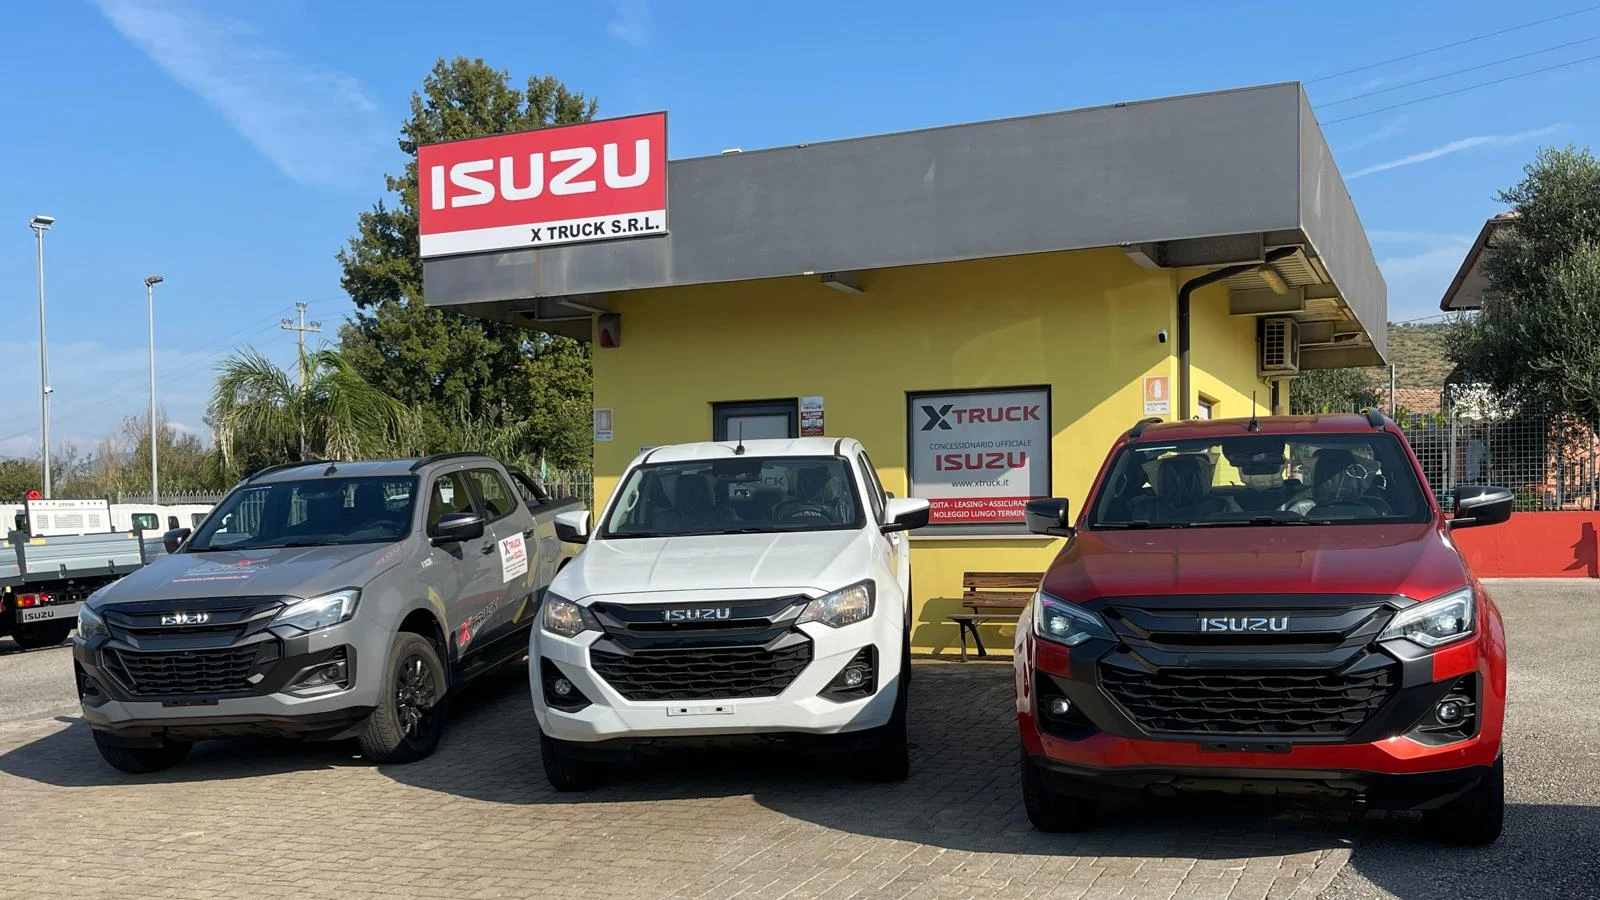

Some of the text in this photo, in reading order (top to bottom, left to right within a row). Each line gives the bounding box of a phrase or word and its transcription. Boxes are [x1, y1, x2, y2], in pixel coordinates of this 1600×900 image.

[431, 138, 650, 211] ISUZU
[531, 217, 660, 242] X TRUCK S.R.L.
[920, 404, 1041, 431] XTRUCK
[929, 439, 1032, 450] CONCESSIONARIO UFFICIALE
[935, 451, 1026, 472] ISUZU
[952, 479, 1009, 488] www.xtruck.it
[954, 500, 984, 508] LEASING
[933, 510, 970, 518] NOLEGGIO
[997, 509, 1025, 517] TERMIN
[24, 610, 54, 621] ISUZU
[161, 613, 209, 626] ISUZU
[665, 607, 731, 621] ISUZU
[1200, 616, 1288, 632] ISUZU
